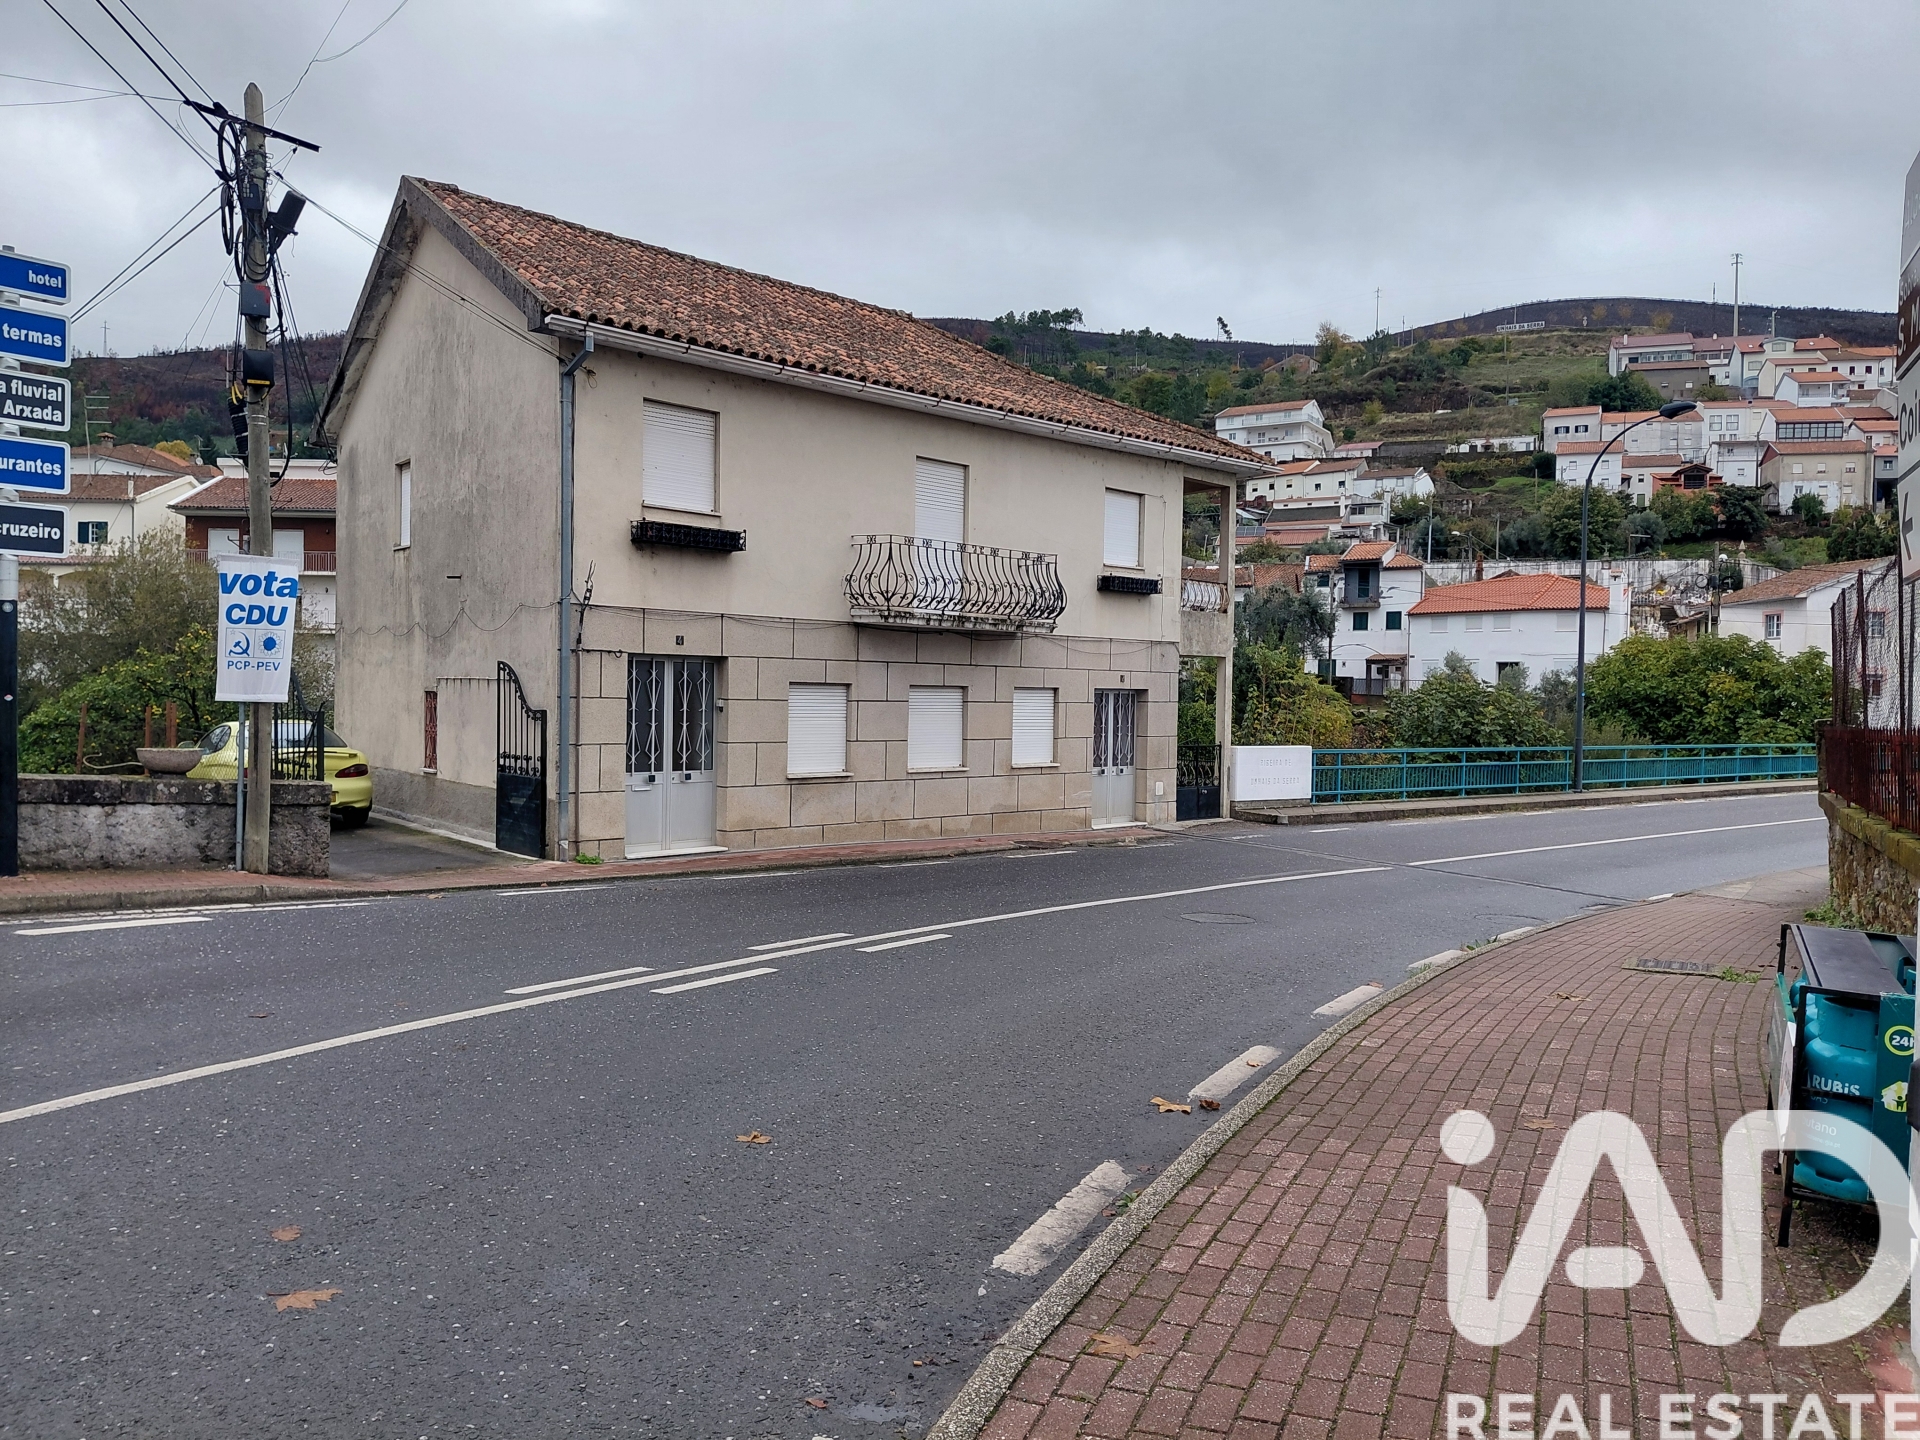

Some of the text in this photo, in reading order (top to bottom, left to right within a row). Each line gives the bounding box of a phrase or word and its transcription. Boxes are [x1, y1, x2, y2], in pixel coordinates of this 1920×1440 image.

[28, 269, 62, 289] hotel
[2, 322, 62, 348] termas
[11, 379, 62, 402] fluvial
[3, 399, 62, 423] Arxada
[1899, 387, 1920, 451] Coi
[0, 457, 62, 476] urantes
[0, 522, 61, 540] ruzeiro
[218, 571, 298, 599] vota
[225, 603, 289, 627] CDU
[227, 660, 281, 672] PCP-PEV
